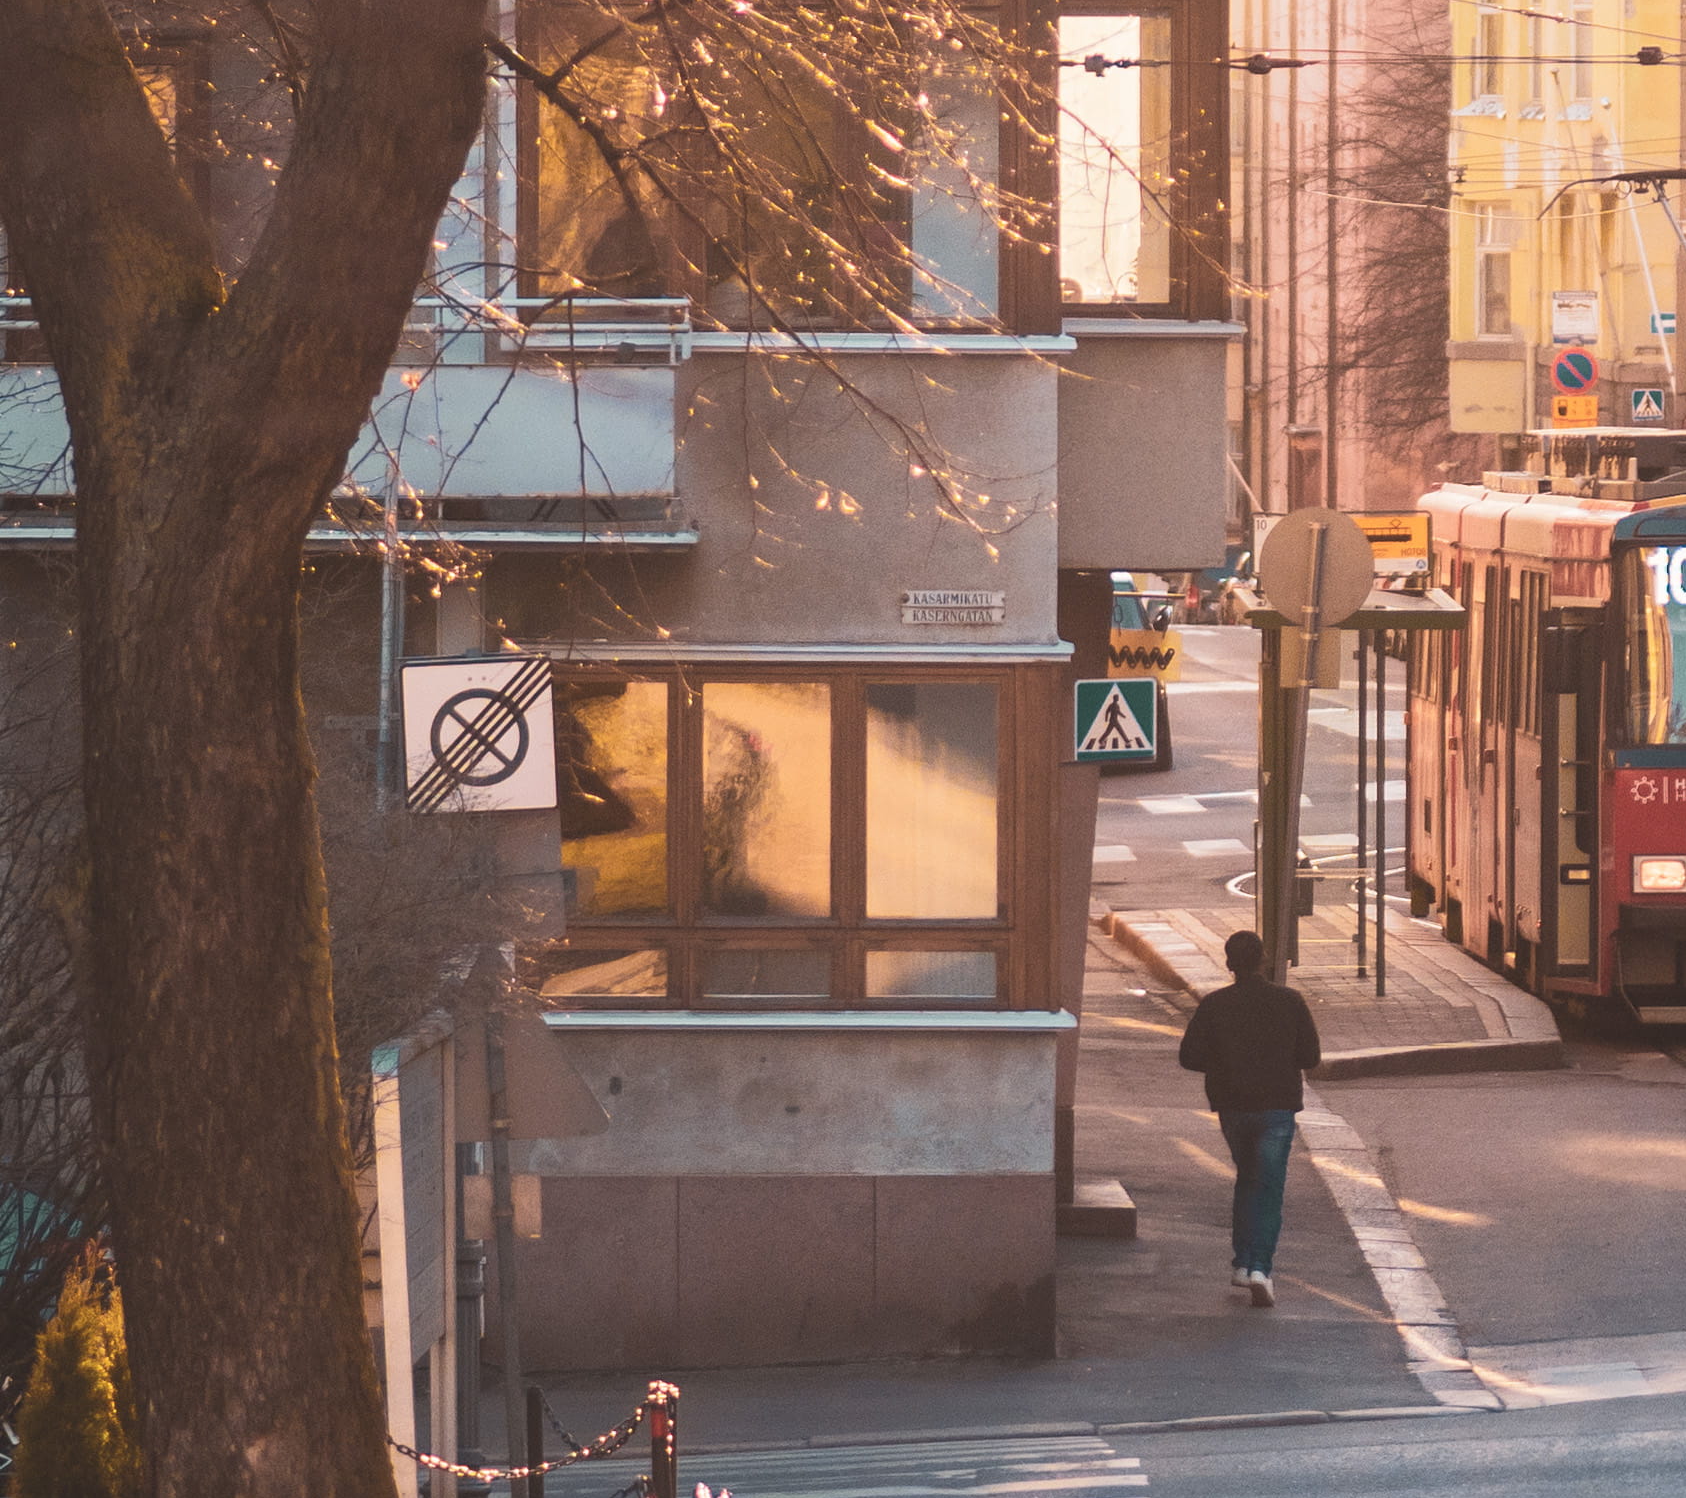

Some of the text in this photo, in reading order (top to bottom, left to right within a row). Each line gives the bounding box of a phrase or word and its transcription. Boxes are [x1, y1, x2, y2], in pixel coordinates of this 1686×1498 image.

[1256, 519, 1268, 531] 10
[913, 592, 993, 605] KASARMIKATU
[912, 609, 993, 622] KASERNGATAN
